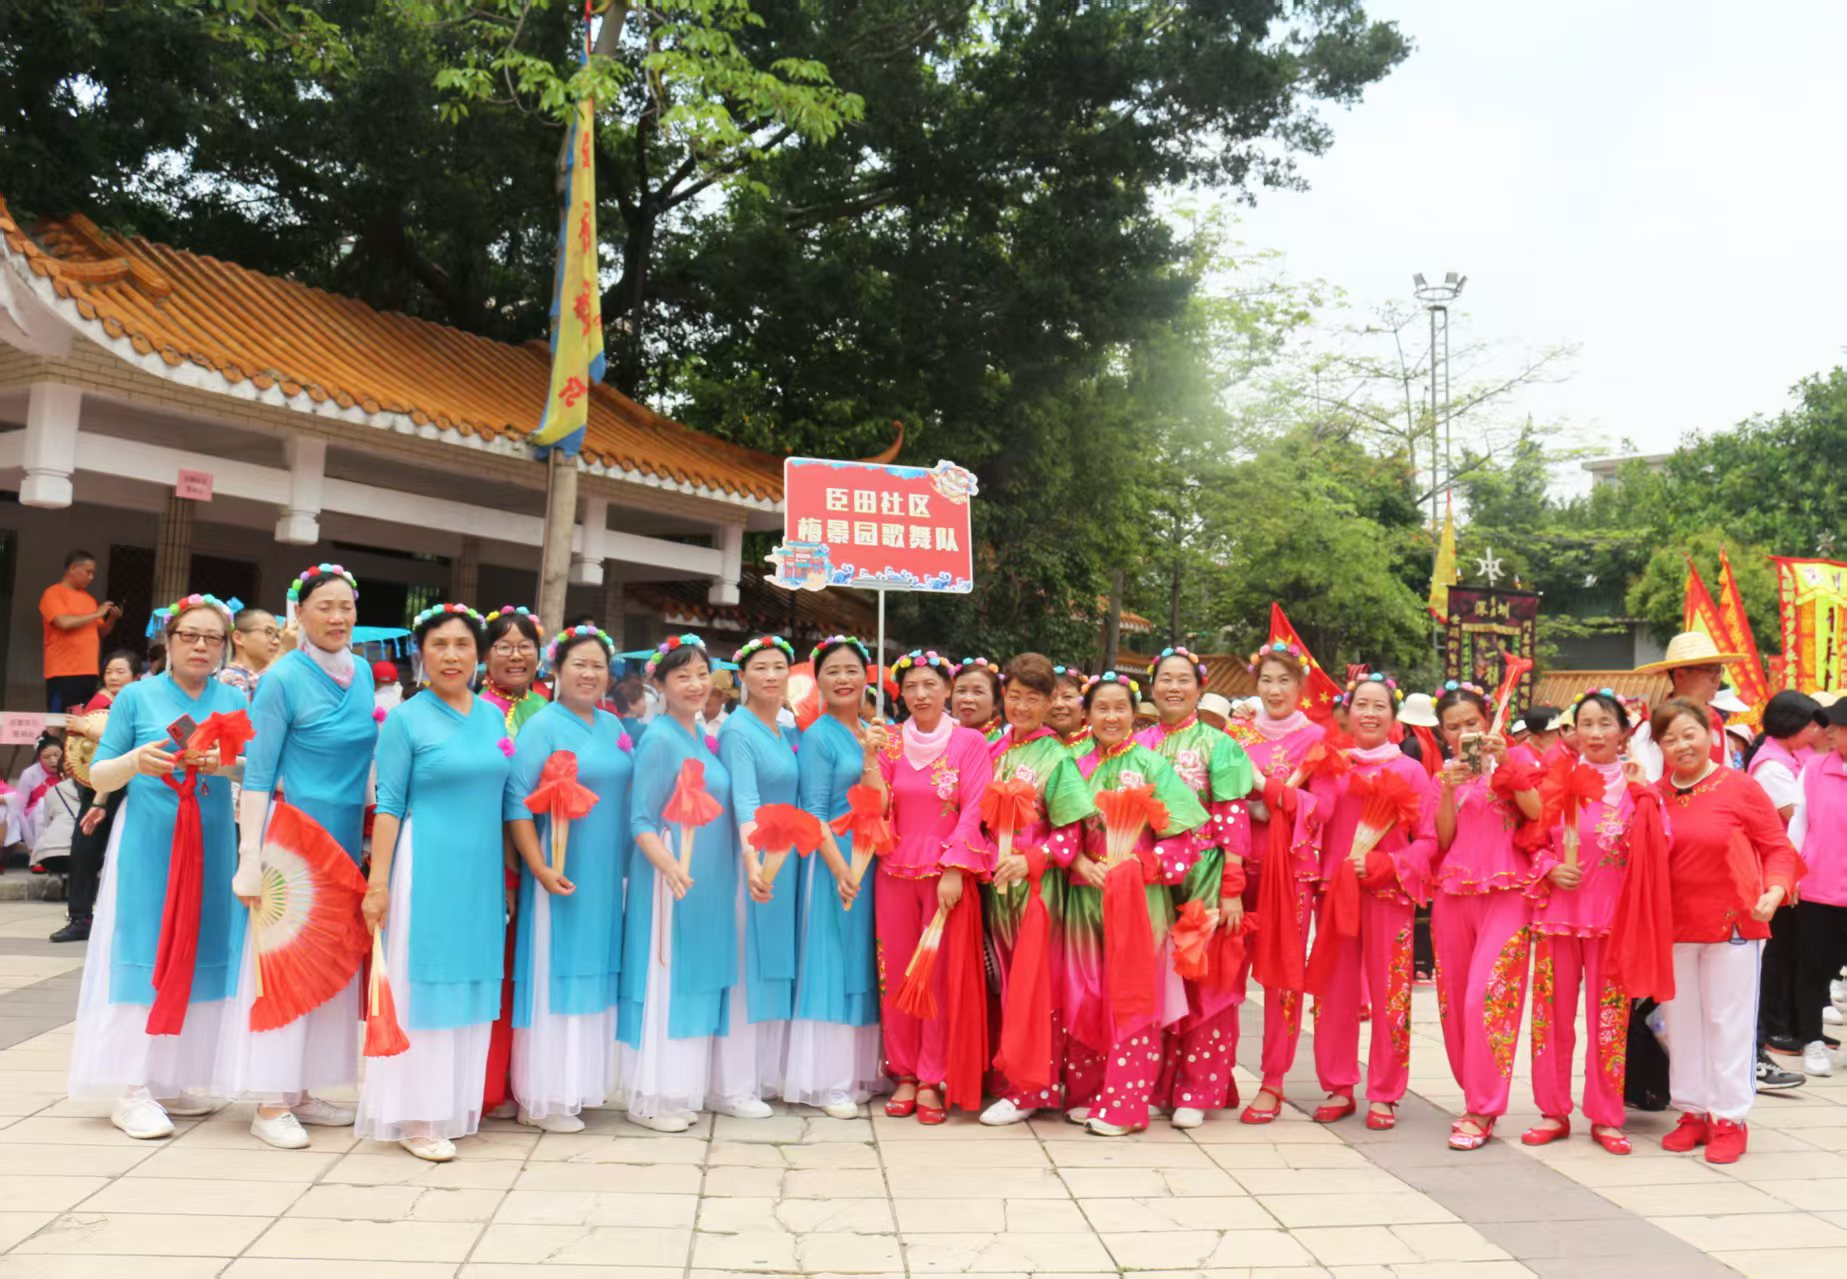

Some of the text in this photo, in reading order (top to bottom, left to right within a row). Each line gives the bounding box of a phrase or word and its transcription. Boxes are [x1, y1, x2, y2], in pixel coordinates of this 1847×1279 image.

[826, 488, 931, 518] 臣田社区
[798, 517, 959, 552] 梅景园歌舞队
